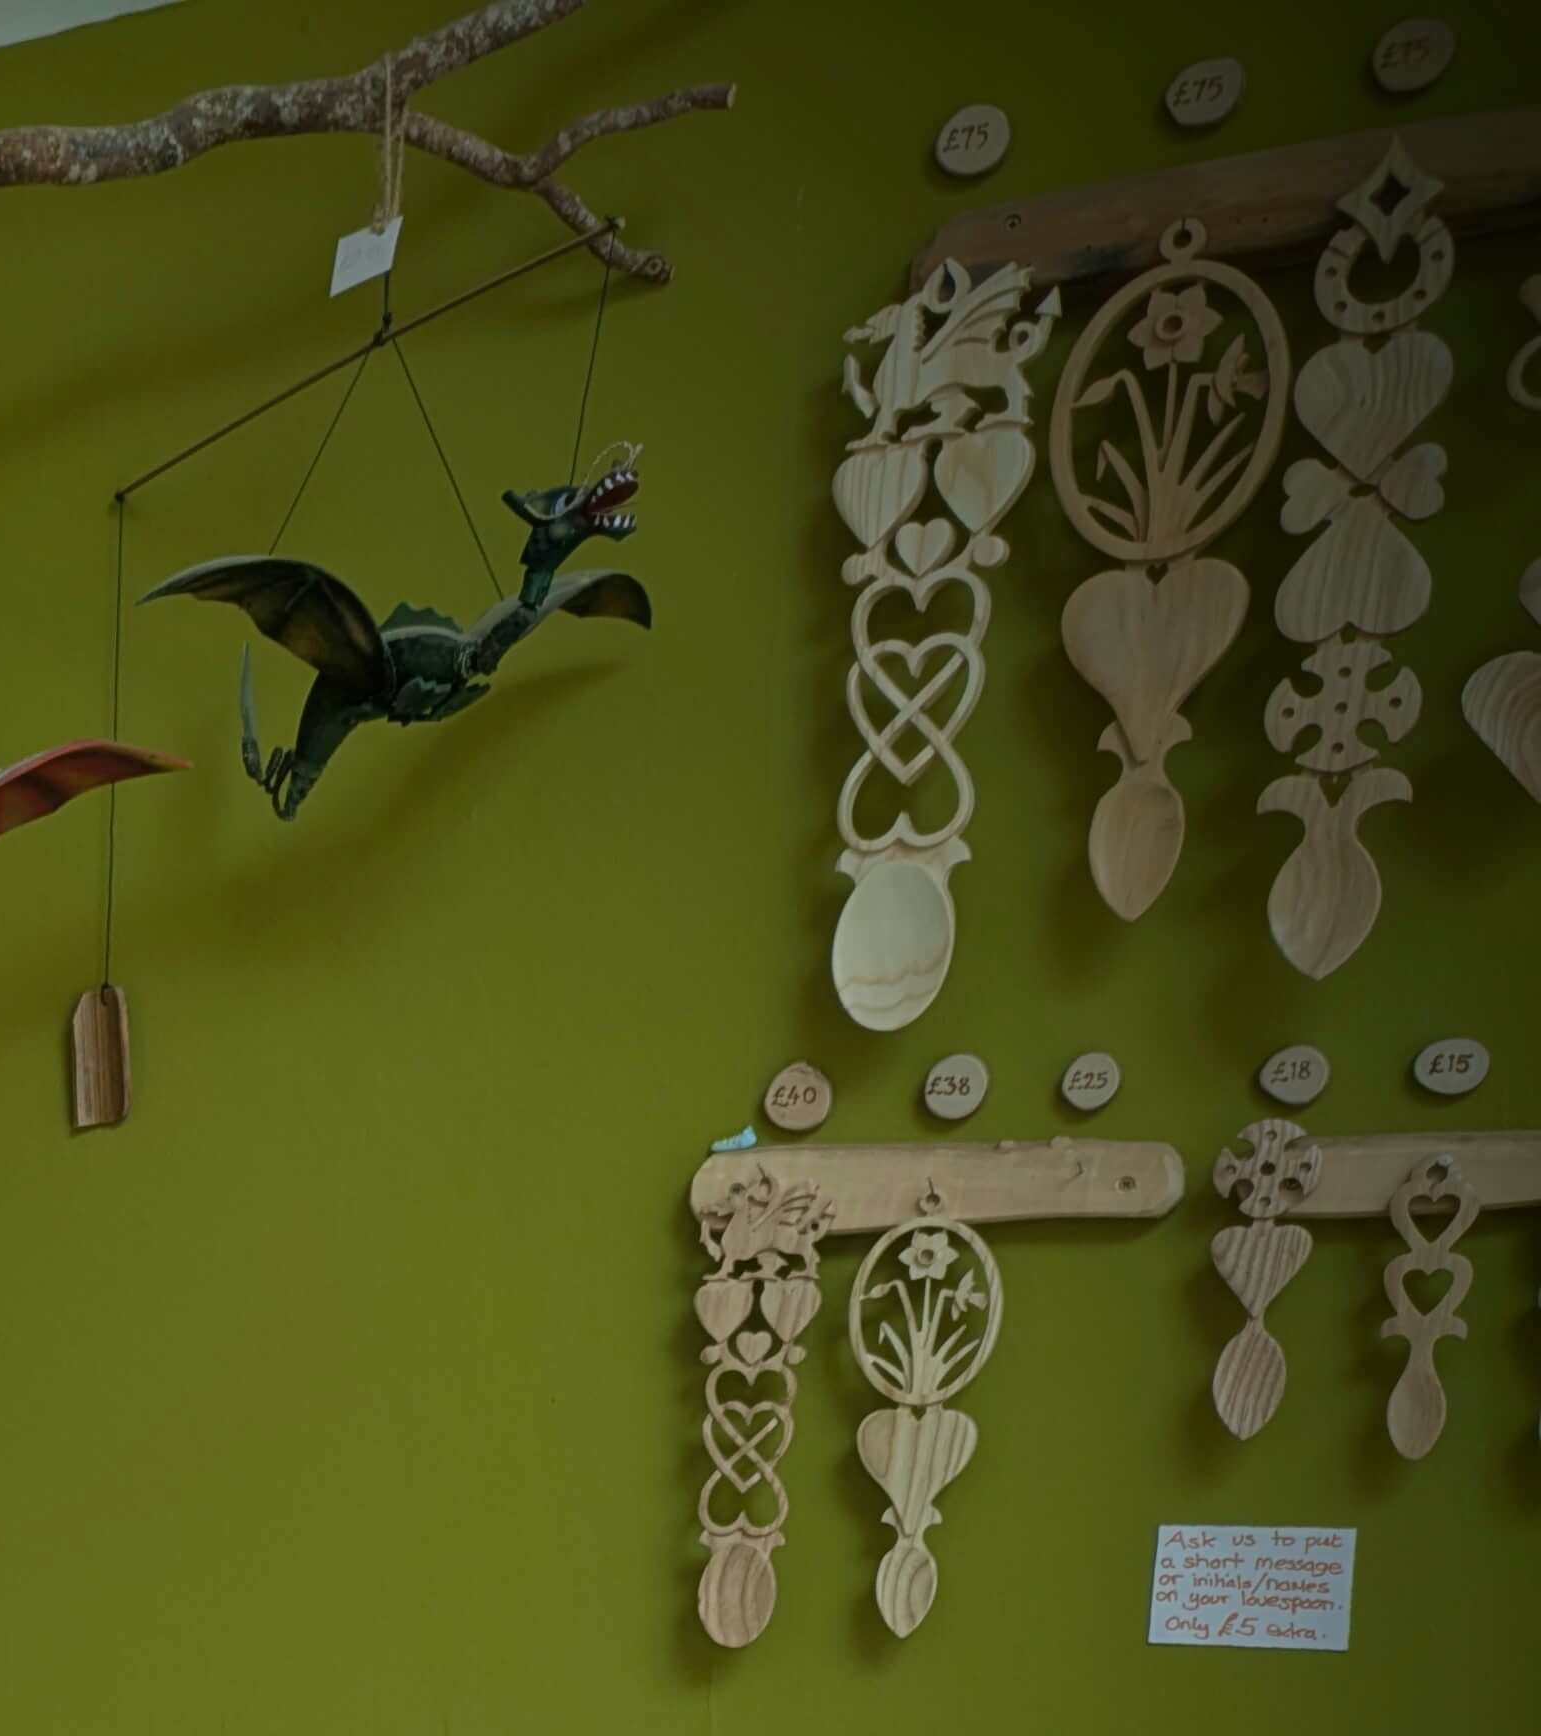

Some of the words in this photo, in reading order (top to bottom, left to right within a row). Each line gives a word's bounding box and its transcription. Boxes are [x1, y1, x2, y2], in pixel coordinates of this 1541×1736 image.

[1380, 33, 1430, 69] £75
[1172, 75, 1223, 107] £75
[942, 122, 990, 153] £75
[1270, 1060, 1312, 1084] £18
[1428, 1053, 1475, 1075] £15
[927, 1075, 972, 1096] £38
[1068, 1071, 1109, 1091] £25
[772, 1085, 818, 1108] £40
[1165, 1530, 1216, 1551] Ask
[1232, 1535, 1256, 1547] us
[1272, 1530, 1296, 1547] to
[1304, 1534, 1343, 1555] put
[1160, 1557, 1175, 1569] a
[1183, 1553, 1246, 1569] short
[1254, 1556, 1344, 1577] message
[1158, 1574, 1184, 1586] or
[1155, 1590, 1178, 1603] on
[1182, 1593, 1230, 1611] your
[1165, 1616, 1211, 1640] Only
[1217, 1612, 1259, 1638] £5
